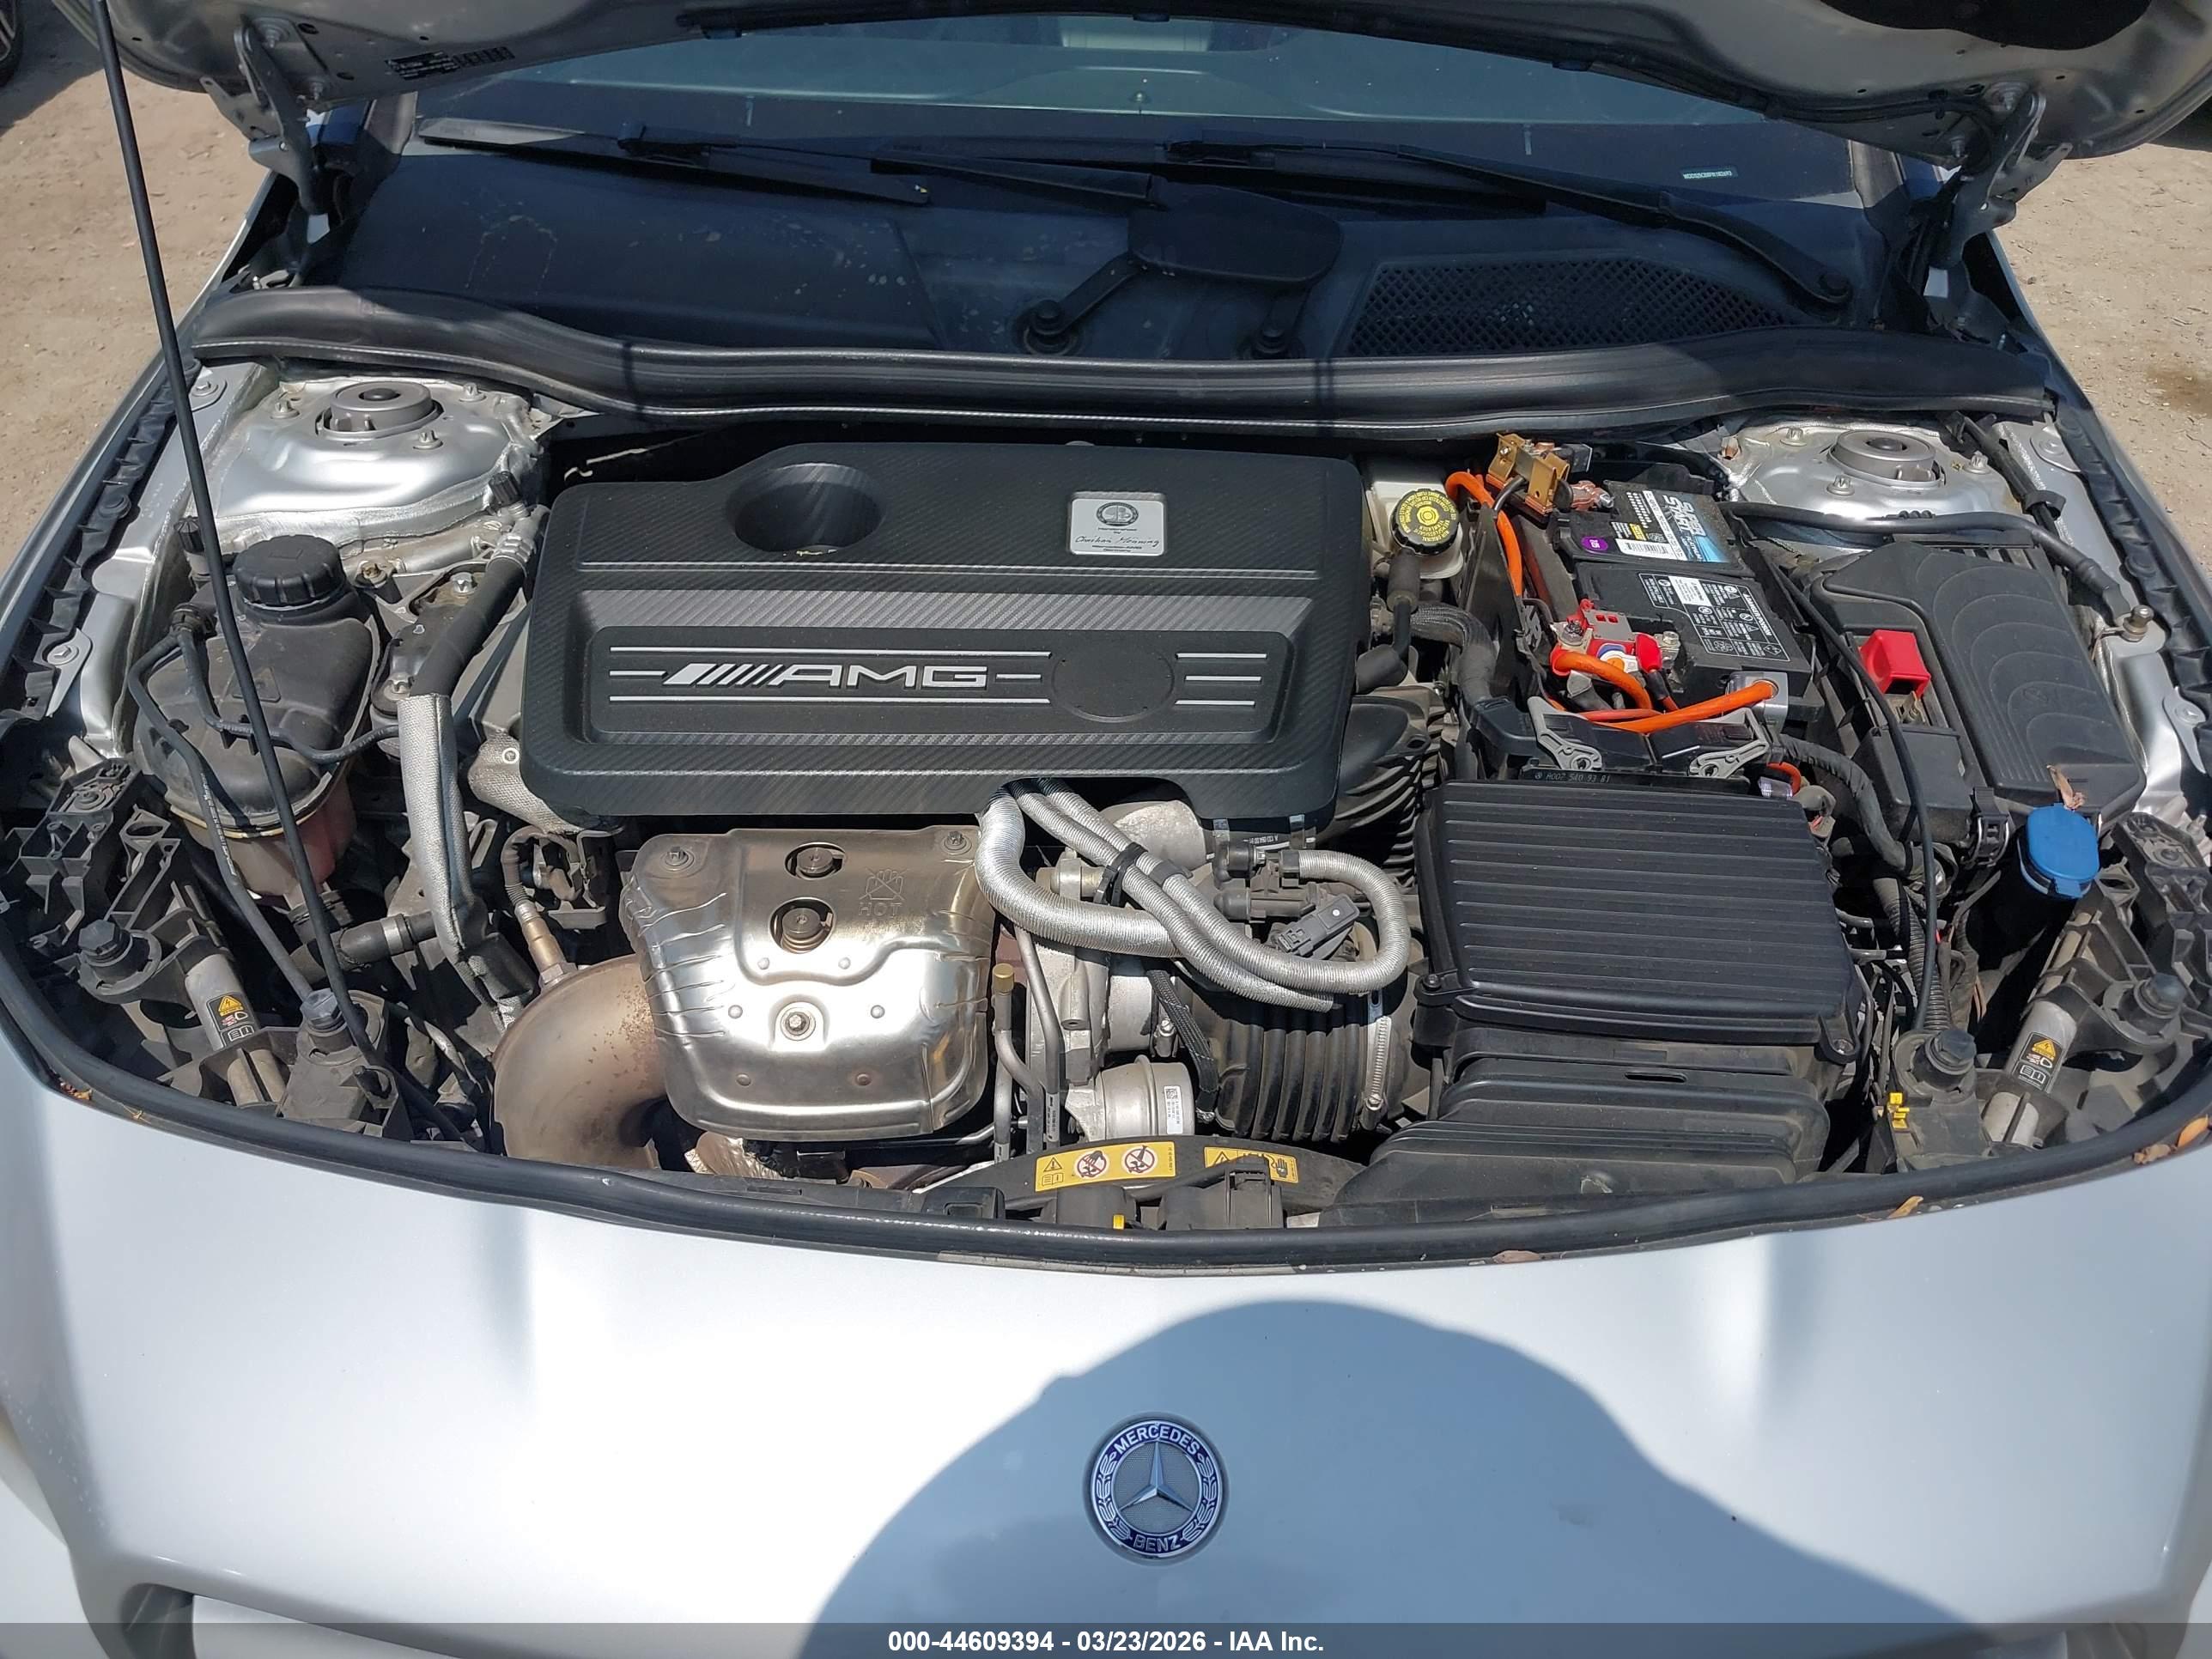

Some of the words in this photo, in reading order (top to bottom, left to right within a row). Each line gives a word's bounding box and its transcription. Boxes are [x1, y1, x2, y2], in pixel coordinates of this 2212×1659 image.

[1662, 495, 1692, 532] START
[769, 665, 988, 689] AMG
[859, 902, 903, 919] HOT
[1114, 1425, 1200, 1455] MERCEDES
[1133, 1534, 1182, 1553] BENZ
